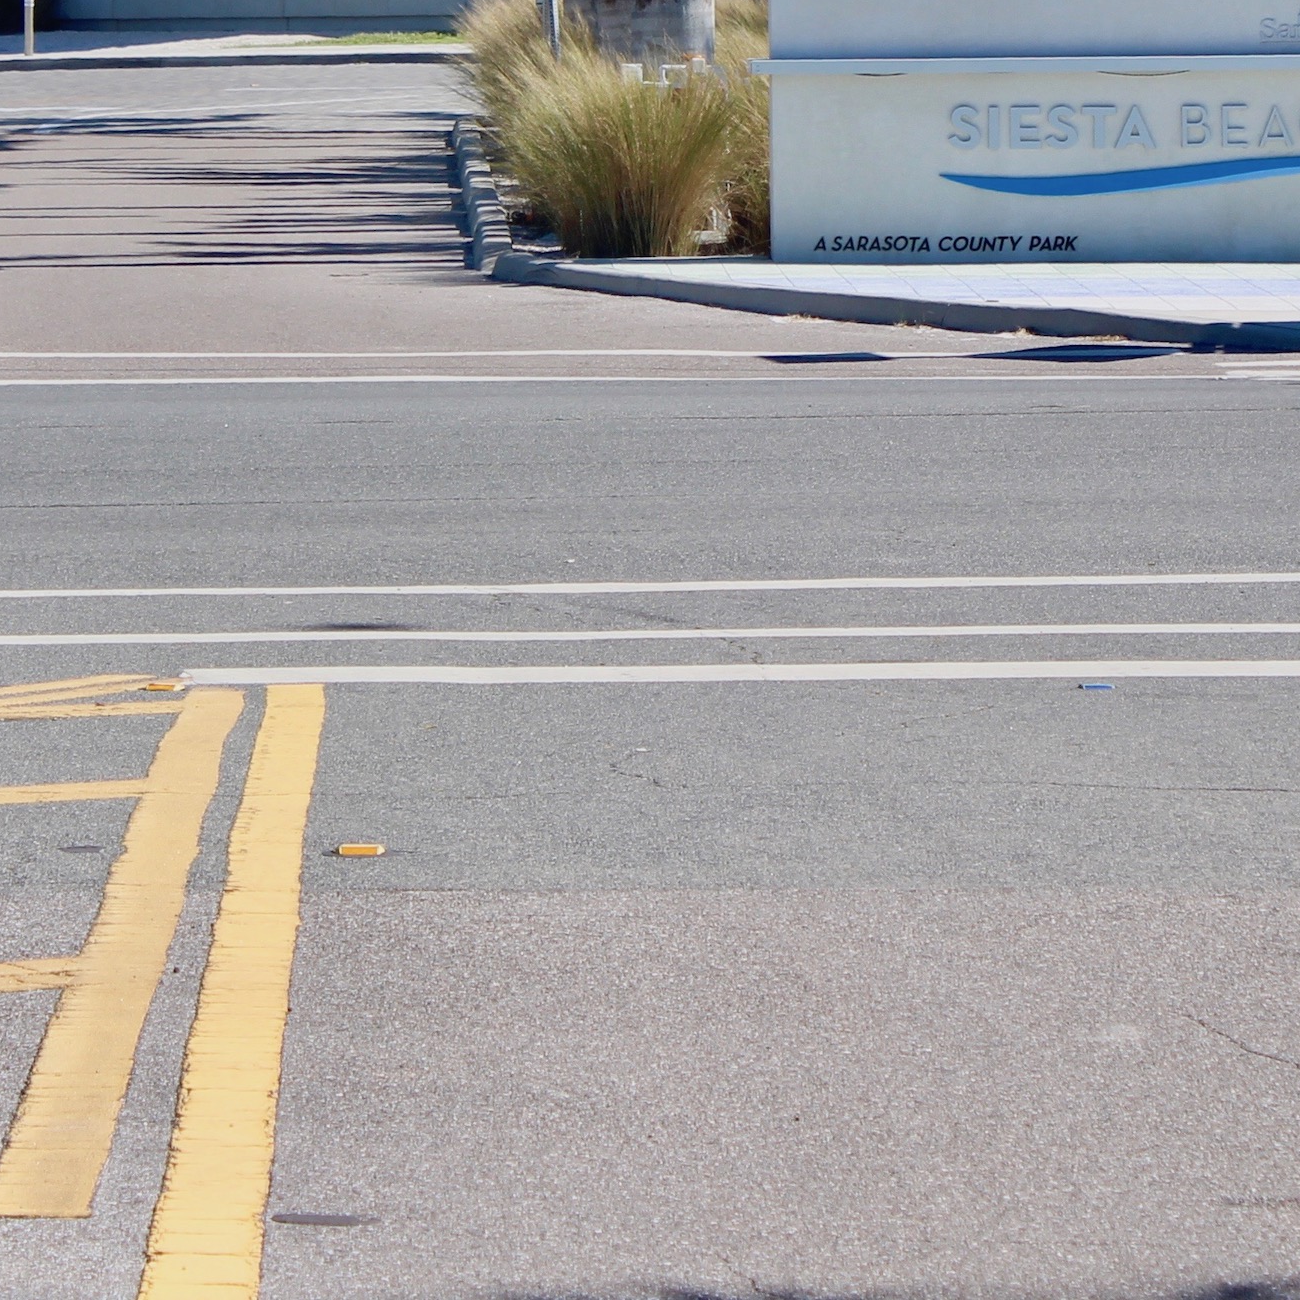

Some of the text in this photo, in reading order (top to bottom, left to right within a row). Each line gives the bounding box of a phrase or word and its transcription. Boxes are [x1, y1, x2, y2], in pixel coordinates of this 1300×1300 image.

[947, 103, 1157, 150] SIESTA
[814, 235, 1079, 252] A SARASOTA COUNTY PARK
